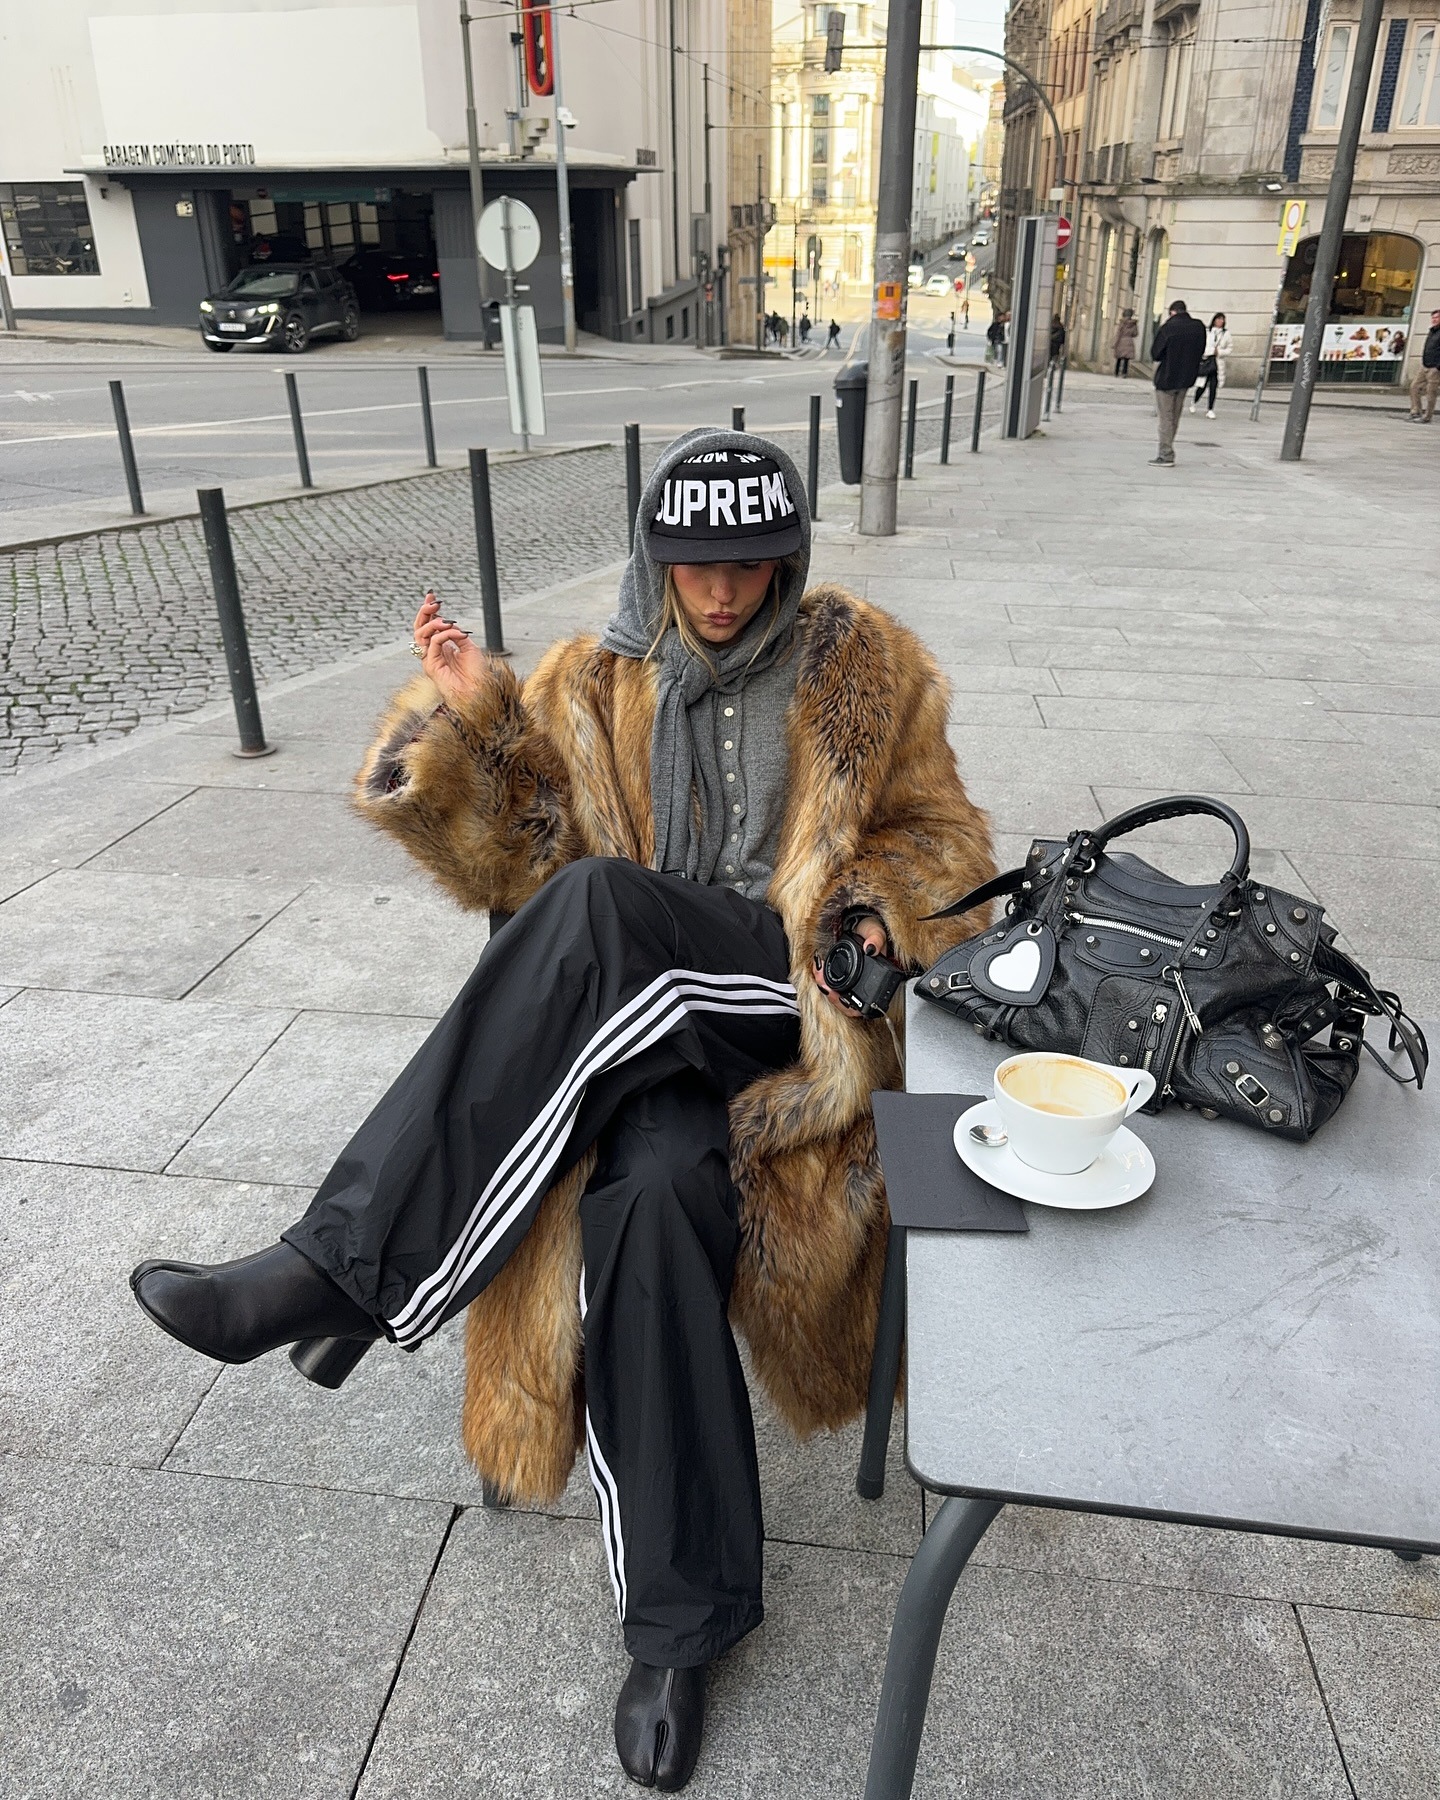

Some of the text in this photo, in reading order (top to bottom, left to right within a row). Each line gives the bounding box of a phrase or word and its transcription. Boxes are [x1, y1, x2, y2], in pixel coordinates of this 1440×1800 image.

[103, 139, 255, 166] GARAGEM COMÉRCIO DO PORTO
